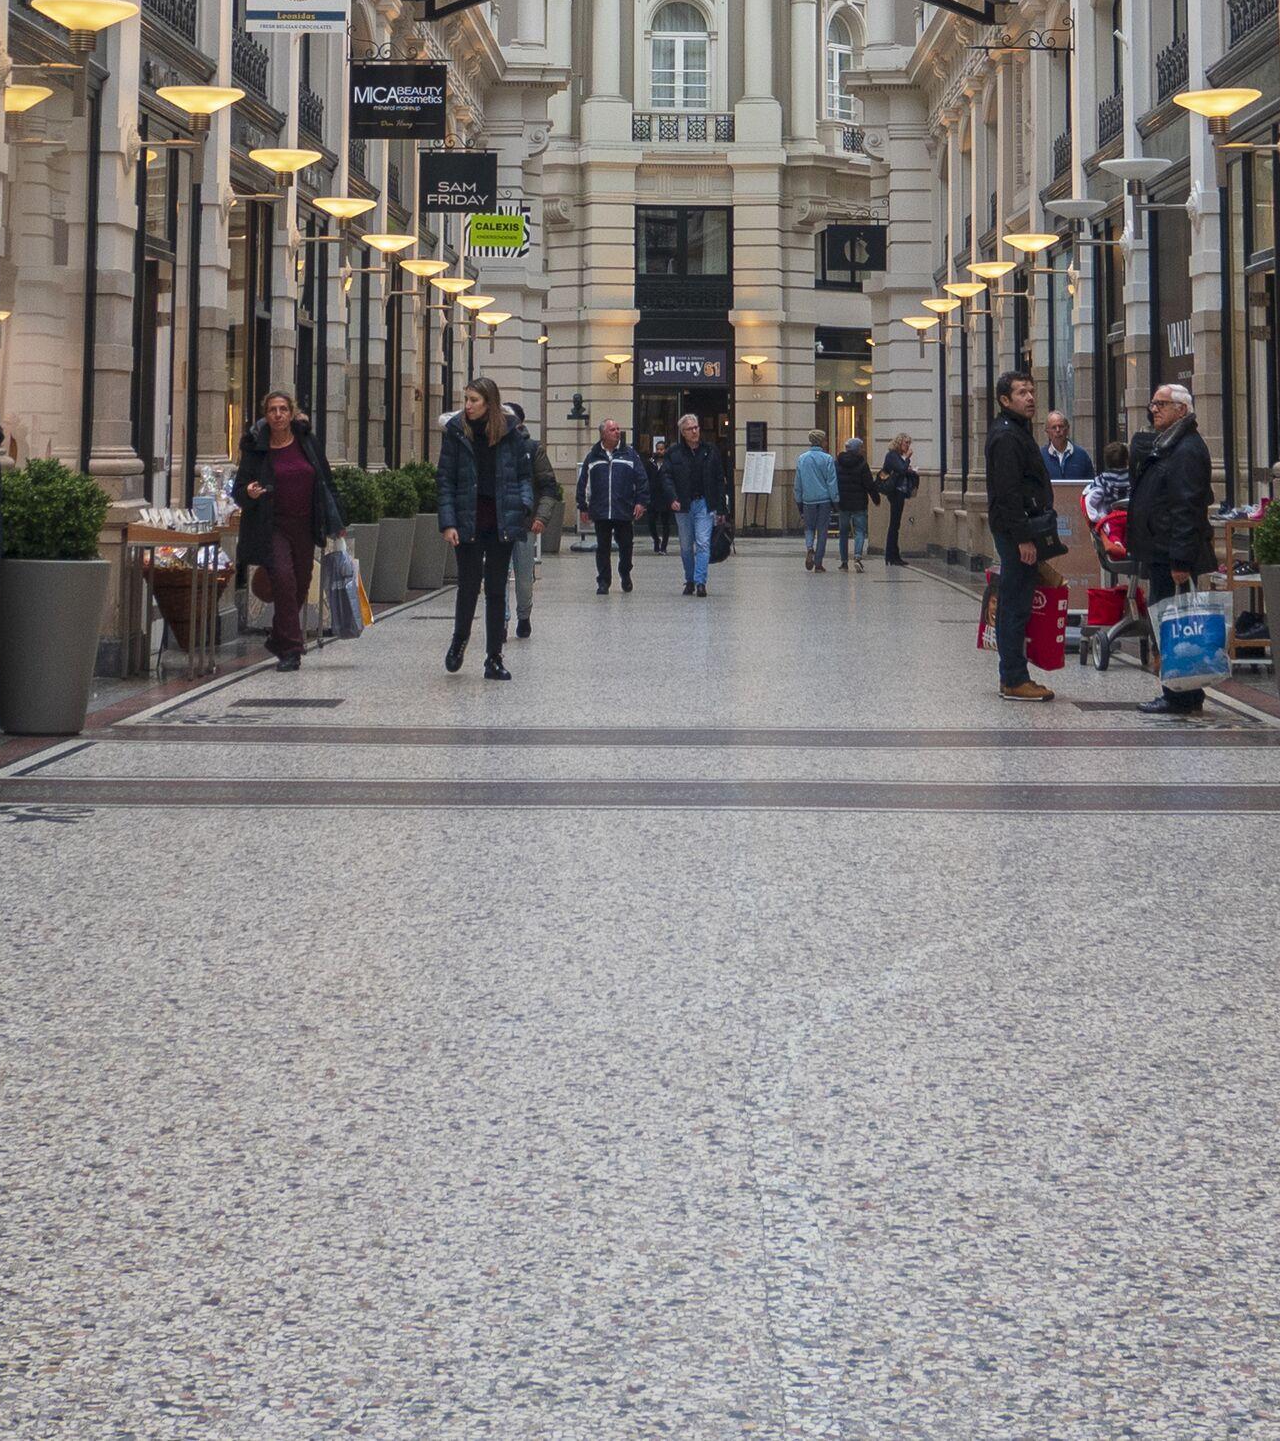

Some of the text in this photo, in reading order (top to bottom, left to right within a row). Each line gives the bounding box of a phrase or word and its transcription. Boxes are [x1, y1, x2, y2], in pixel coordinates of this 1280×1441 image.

[277, 12, 315, 21] Leonidas
[354, 86, 442, 104] MICA BEAUTY
[398, 95, 443, 104] cosmetics
[438, 181, 477, 193] SAM
[427, 194, 488, 205] FRIDAY
[475, 222, 520, 232] CALEXIS
